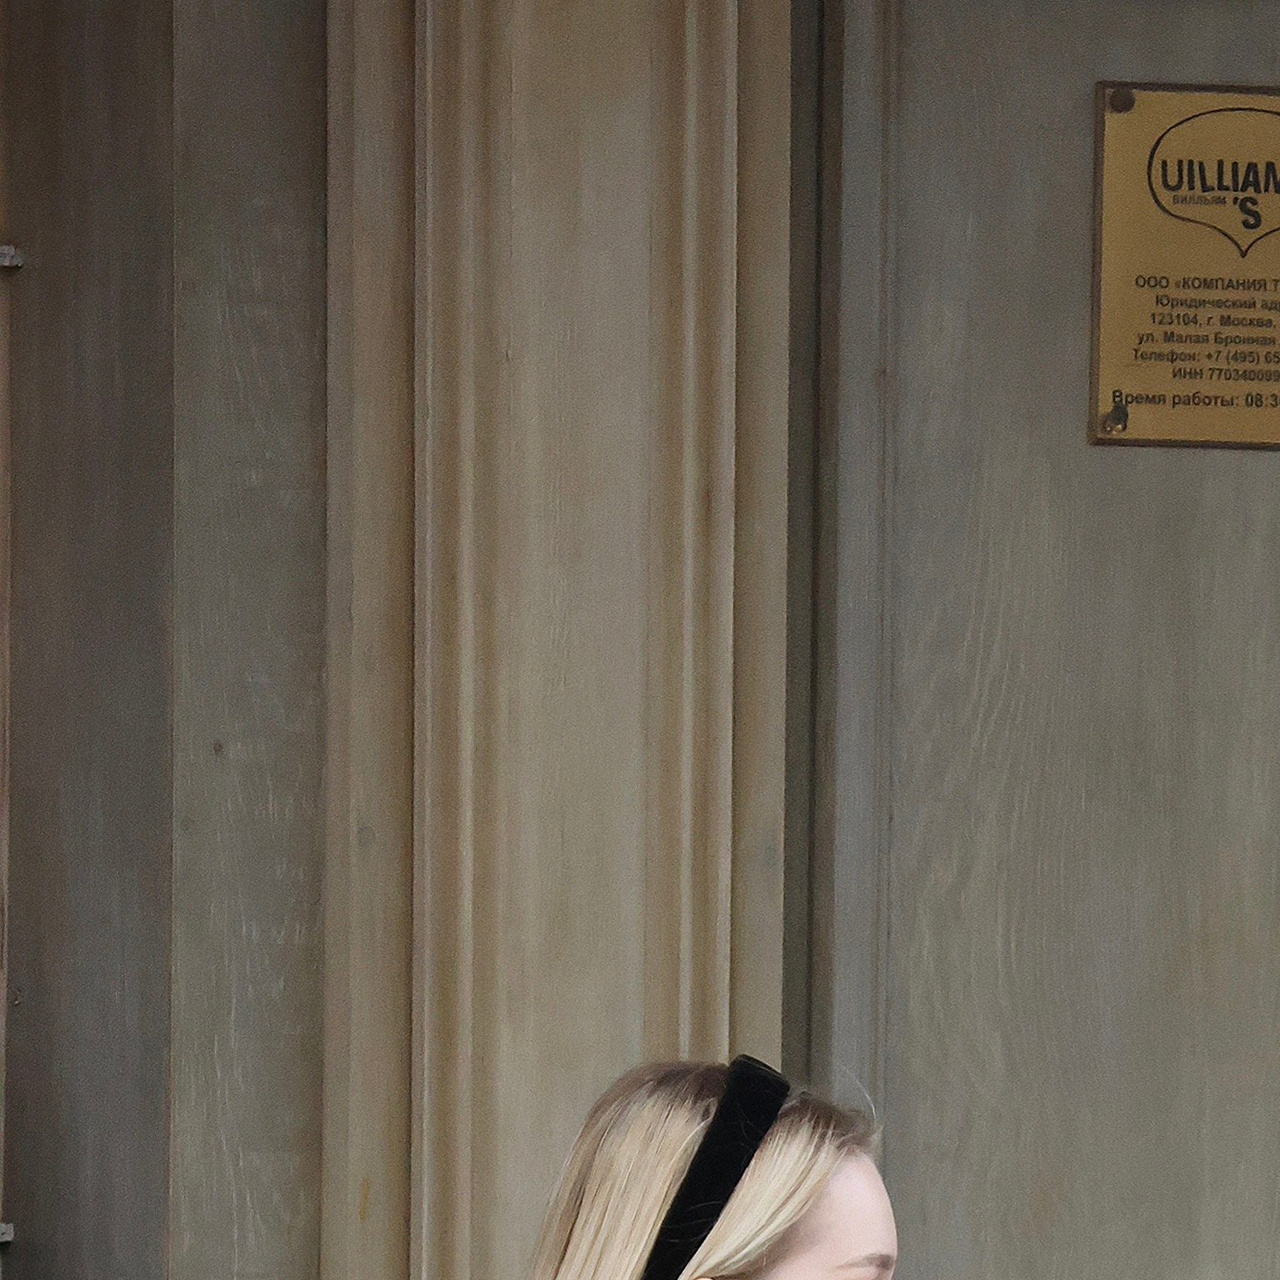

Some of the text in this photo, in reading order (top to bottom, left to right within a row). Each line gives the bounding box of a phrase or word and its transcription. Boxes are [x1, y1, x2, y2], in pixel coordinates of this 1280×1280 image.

[1135, 275, 1170, 289] ООО
[1155, 294, 1257, 310] Юридический
[1150, 312, 1202, 327] 123104,
[1219, 314, 1277, 328] Москва,
[1137, 332, 1158, 345] ул.
[1163, 331, 1209, 344] Малая
[1214, 332, 1276, 347] Бронная
[1133, 348, 1200, 363] Телефон:
[1206, 350, 1222, 362] +7
[1226, 350, 1260, 365] (495)
[1172, 367, 1204, 379] ИНН
[1112, 390, 1167, 406] Время
[1172, 391, 1239, 408] работы:
